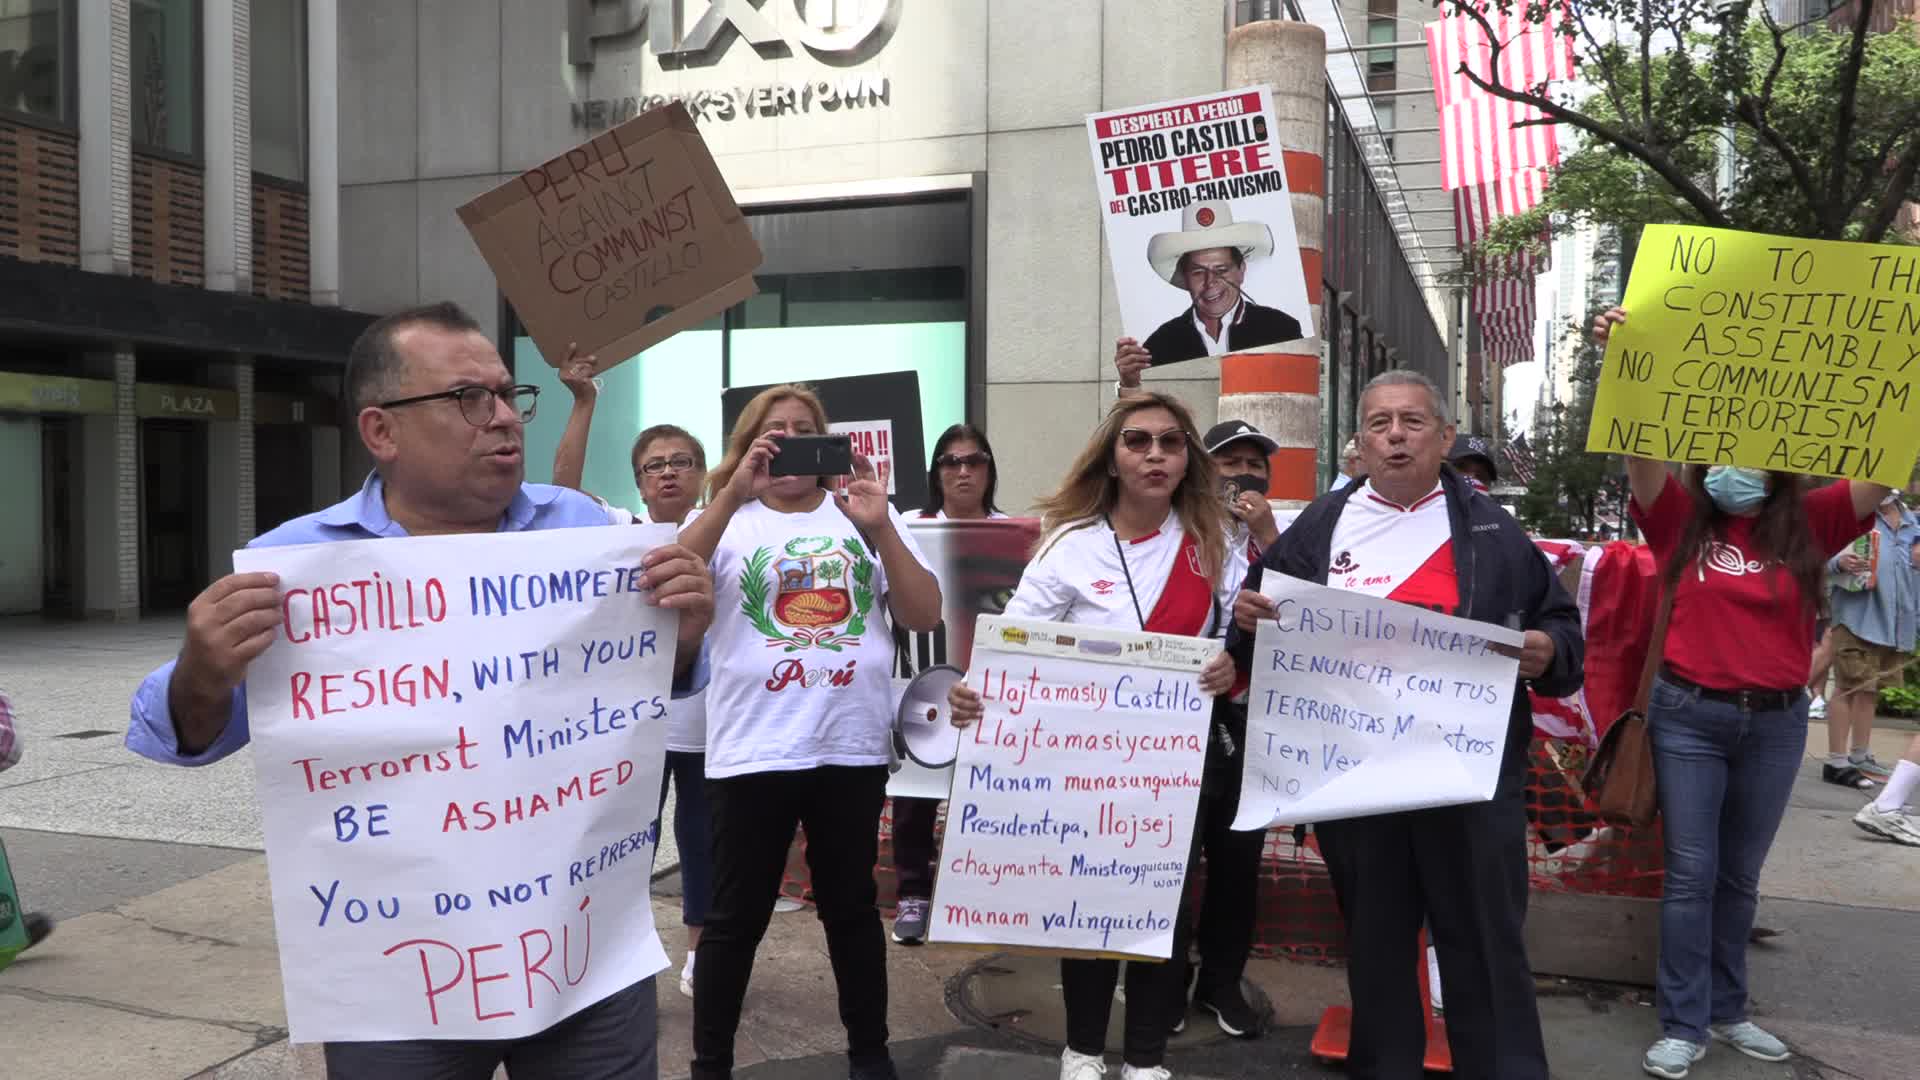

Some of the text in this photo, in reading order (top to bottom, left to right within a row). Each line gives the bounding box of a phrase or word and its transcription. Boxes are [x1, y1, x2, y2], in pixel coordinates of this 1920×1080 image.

[1100, 115, 1269, 169] PEDRO CASTILLO
[1109, 107, 1195, 136] DESPIERTA
[521, 130, 632, 216] PERU
[1104, 143, 1274, 196] TITERE
[1109, 170, 1283, 217] DEL CASTRO-CHAVISMO
[537, 159, 657, 264] AGAINST
[549, 185, 697, 294] COMMUNIST
[1669, 234, 1920, 295] NO TO TH
[583, 242, 702, 321] CASTILLO
[1682, 321, 1920, 373] ASSEMBLY
[160, 393, 216, 415] PLAZA
[1617, 348, 1911, 413] NO COMMUNISM
[1658, 391, 1877, 443] TERRORISM
[1607, 416, 1884, 479] NEVER AGAIN
[290, 629, 657, 722] RESIGN, WITH YOUR
[765, 658, 857, 693] Perú
[1113, 674, 1202, 712] Castillo
[1406, 674, 1443, 695] CON
[1453, 680, 1499, 705] TUS
[1265, 688, 1386, 735] TERRORISTAS
[1263, 731, 1309, 766] Ten
[333, 759, 634, 843] BE ASHAMED
[969, 763, 1052, 793] Manam
[1262, 775, 1301, 796] NO
[951, 848, 1064, 886] chaymanta
[434, 891, 472, 916] DO
[488, 873, 554, 908] NOT
[944, 903, 1029, 929] manam
[382, 895, 592, 1026] PERÚ
